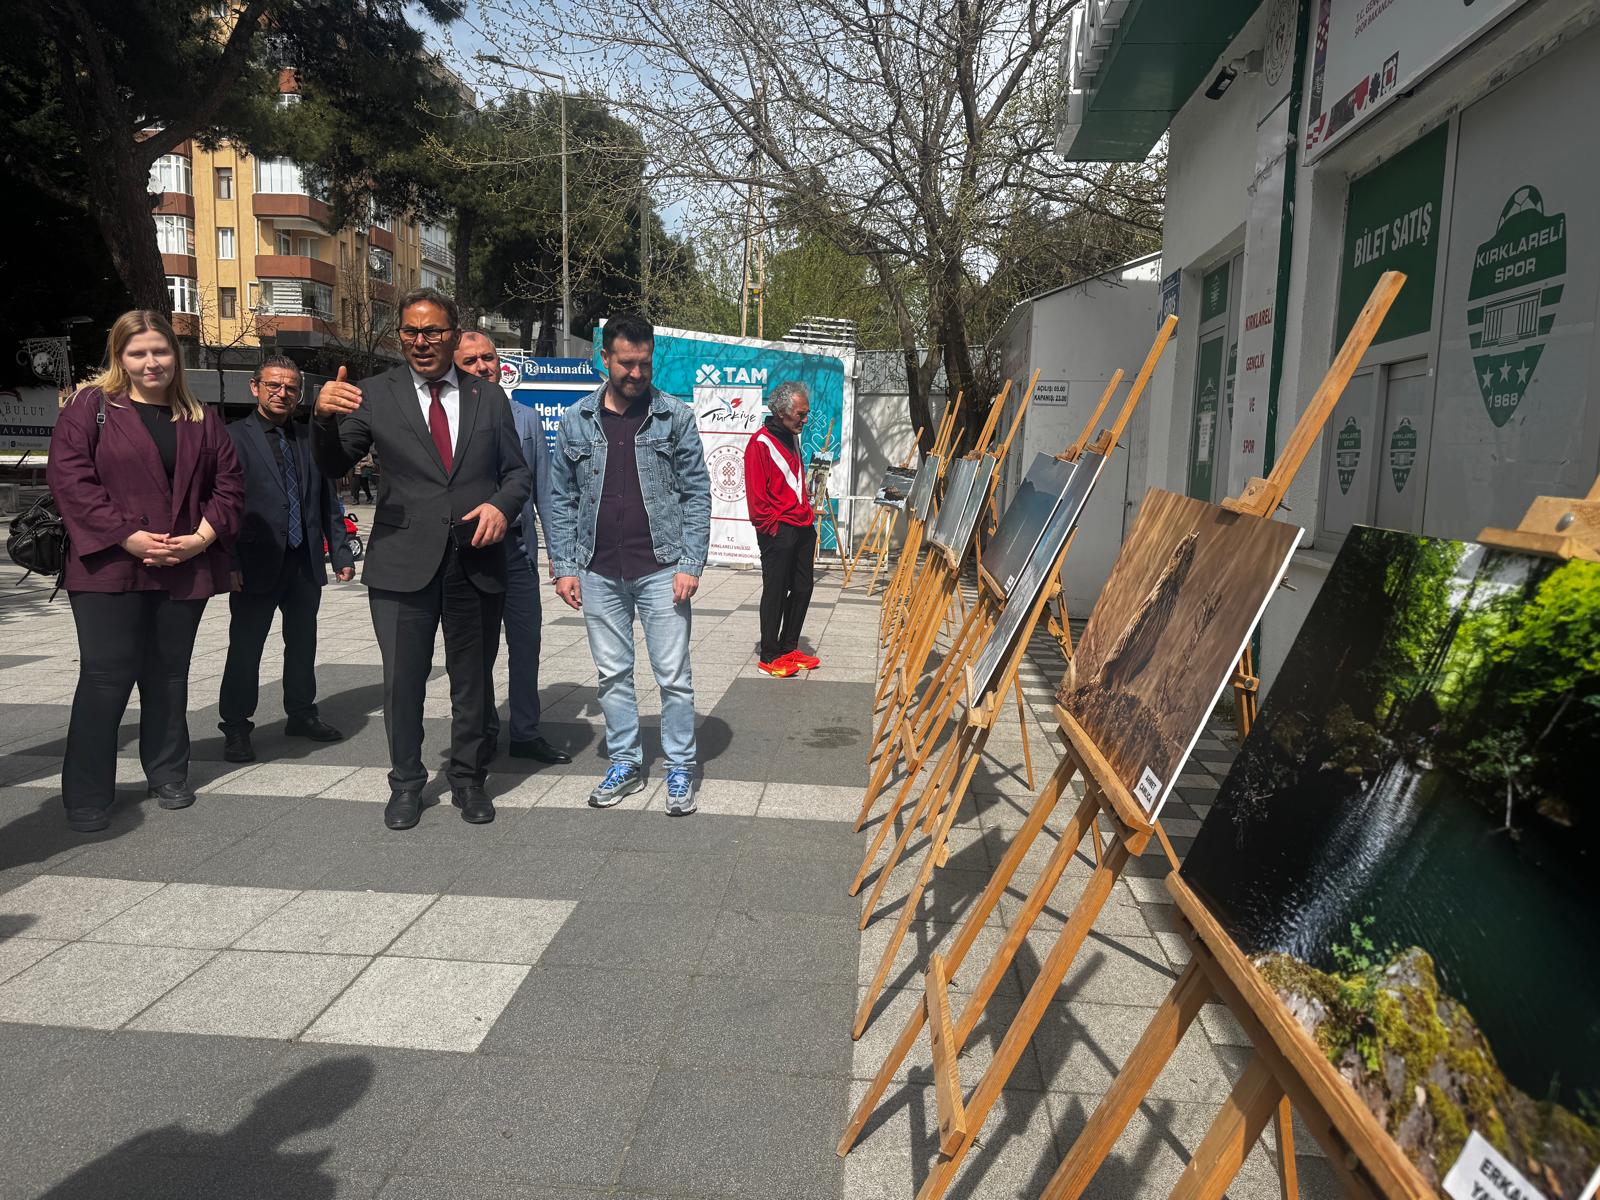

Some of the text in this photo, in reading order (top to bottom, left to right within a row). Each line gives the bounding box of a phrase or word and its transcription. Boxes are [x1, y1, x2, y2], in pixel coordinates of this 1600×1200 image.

[1354, 202, 1433, 269] BİLET SATIŞ
[1476, 218, 1564, 268] KIRKLARELİ
[1494, 257, 1537, 284] SPOR
[1246, 303, 1273, 331] KIRKLARELİ
[525, 363, 593, 376] Bankamatik
[1246, 352, 1265, 373] GENÇLİK
[723, 367, 767, 384] TAM
[1488, 392, 1518, 408] 1968
[1242, 440, 1255, 454] SPOR
